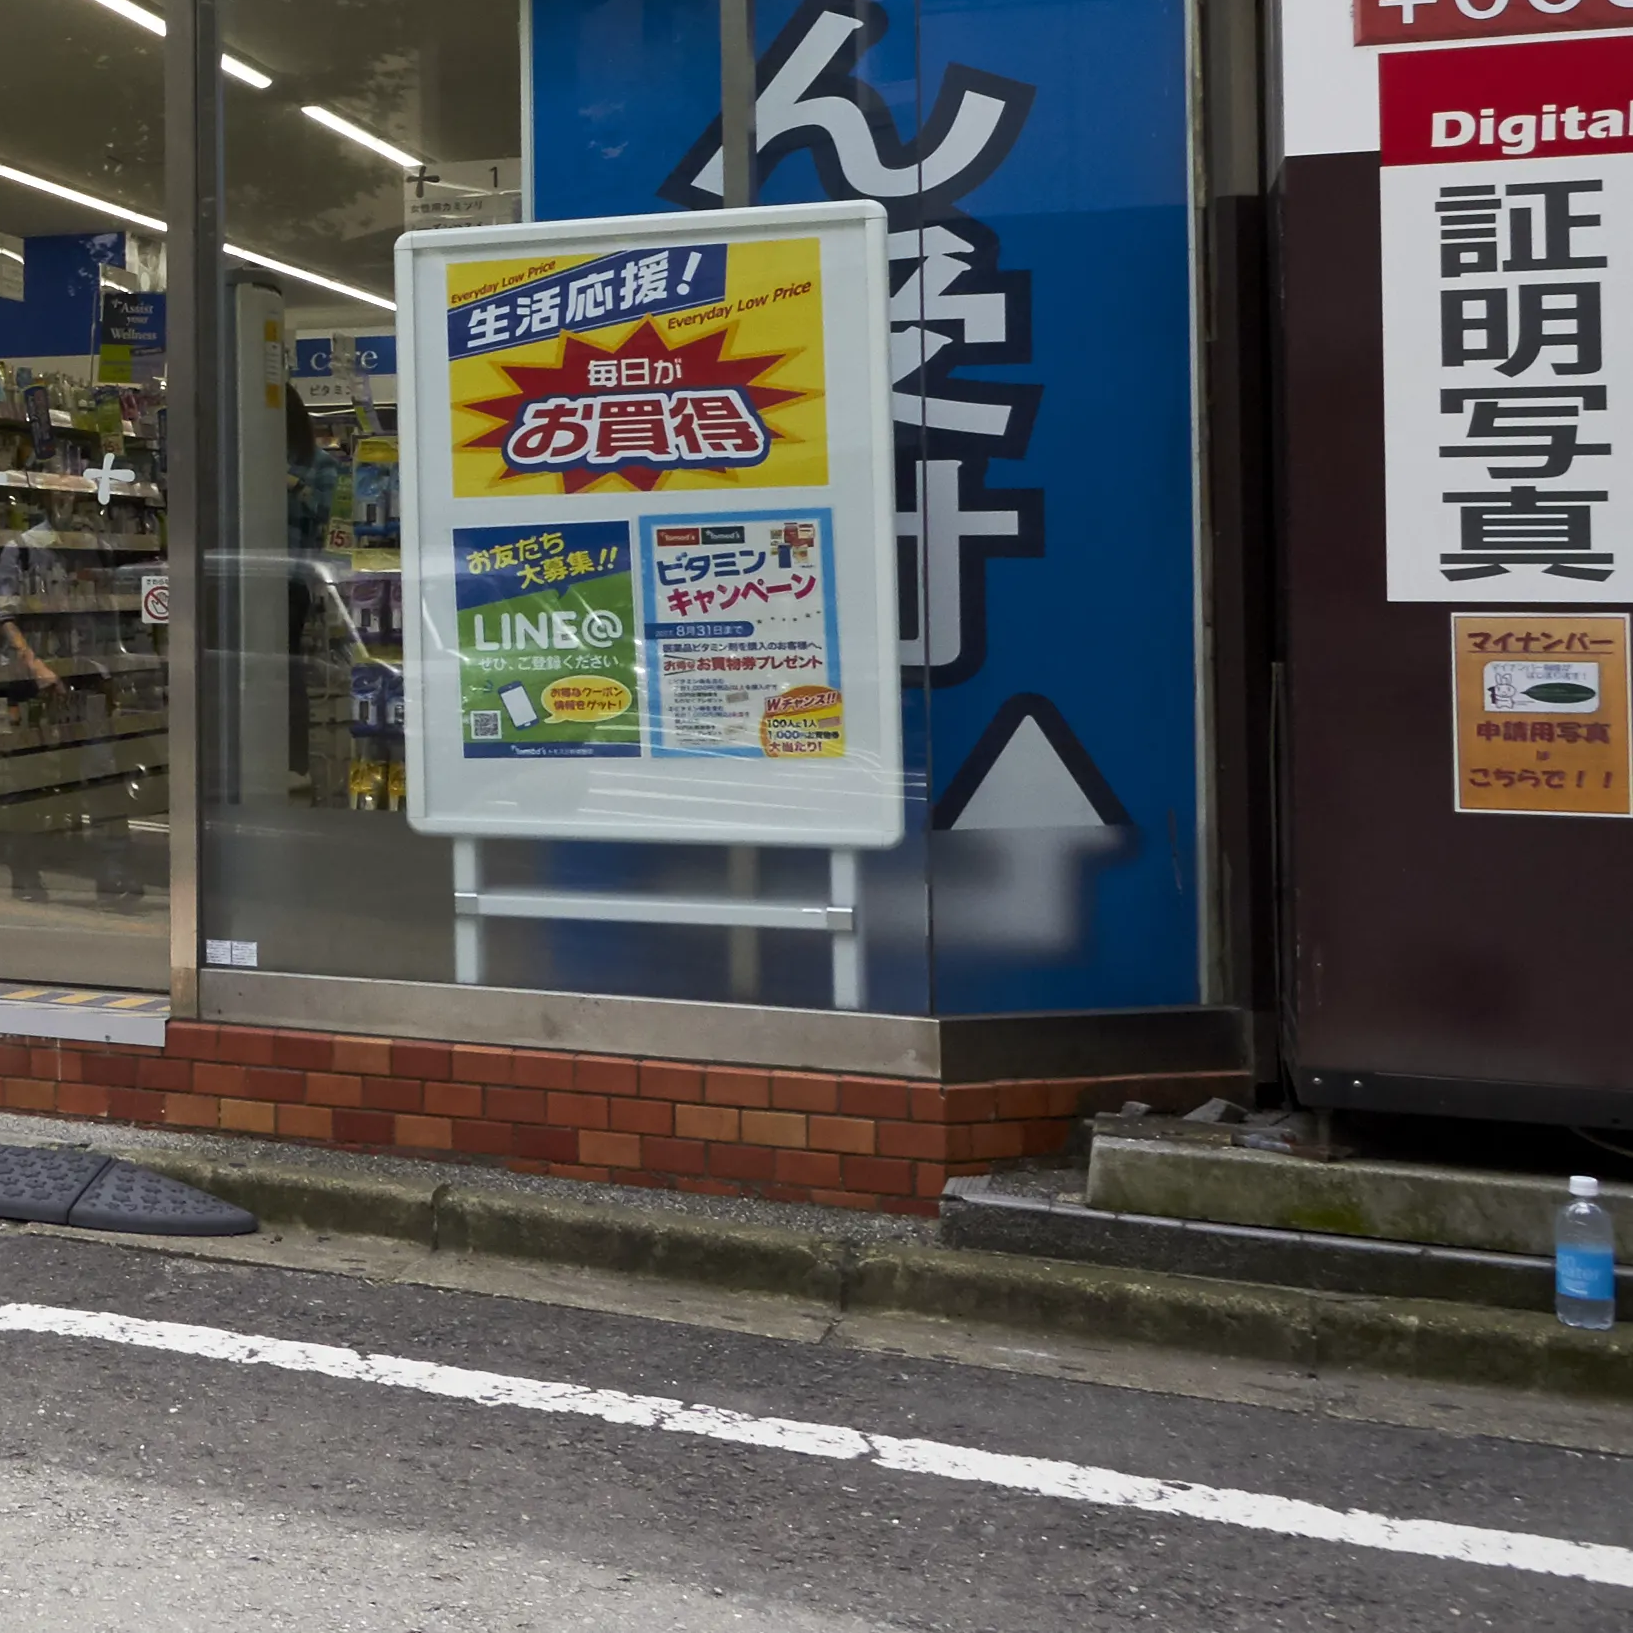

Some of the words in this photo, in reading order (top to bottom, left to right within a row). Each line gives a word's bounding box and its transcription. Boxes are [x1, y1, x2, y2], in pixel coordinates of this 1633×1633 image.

[451, 281, 498, 304] Everyday
[502, 272, 525, 288] Low
[528, 260, 556, 279] Price
[467, 250, 702, 348] 生活応援!
[668, 304, 733, 330] Everyday
[738, 292, 768, 312] Low
[773, 279, 812, 300] Price
[111, 328, 157, 340] Wellness
[588, 357, 682, 387] 毎日が
[1435, 179, 1615, 582] 証明写真
[510, 396, 761, 459] お買得
[466, 532, 564, 575] お友だち
[518, 546, 618, 589] 大募集!!
[656, 550, 766, 586] ビタミン
[667, 573, 816, 617] キャンペーン
[474, 609, 623, 652] LINE@
[676, 625, 743, 637] 8月31日まで
[1468, 632, 1614, 651] マイナンバー
[550, 686, 624, 698] お得なクーポン
[553, 698, 622, 711] 情報をゲット!
[766, 692, 837, 712] Wチャンス!!
[769, 741, 823, 753] 大当たり!
[1477, 721, 1611, 744] 申請用写真
